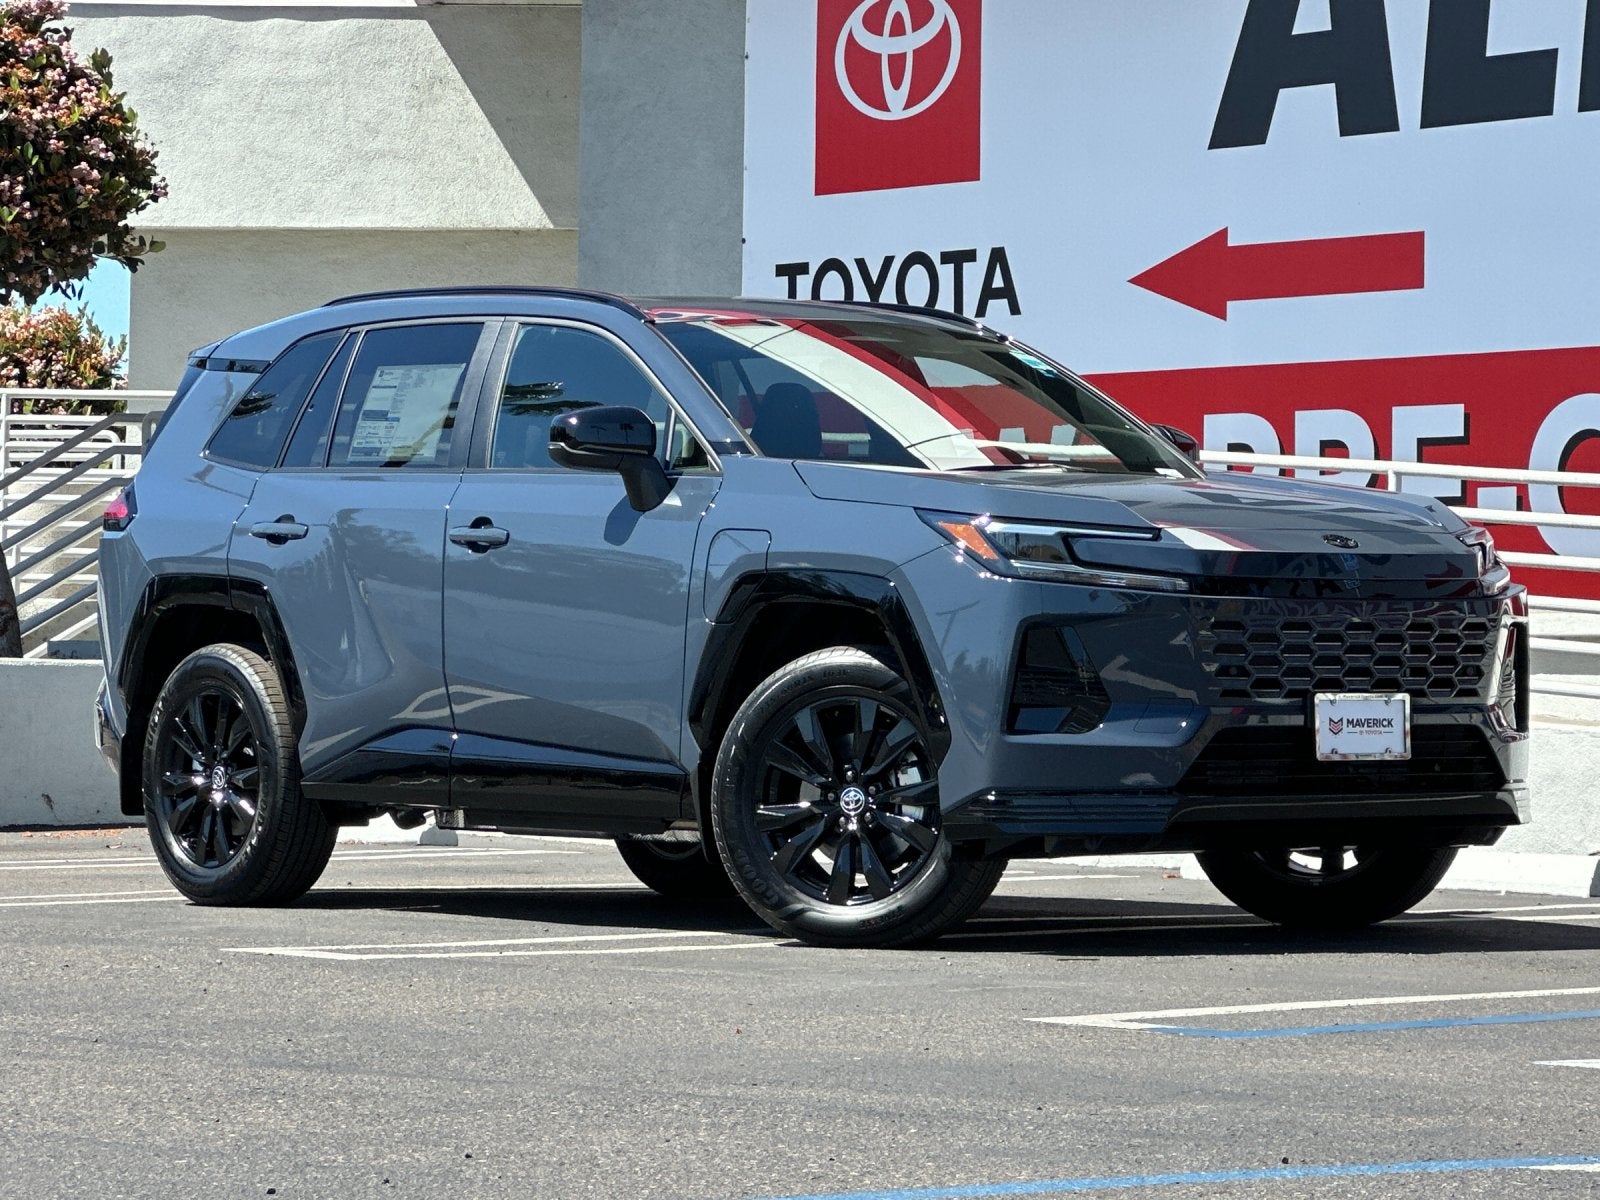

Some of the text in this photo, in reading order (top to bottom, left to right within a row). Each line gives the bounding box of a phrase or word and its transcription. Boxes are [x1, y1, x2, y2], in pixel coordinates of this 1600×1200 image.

[1208, 0, 1600, 150] AL
[775, 246, 1022, 318] TOYOTA
[1346, 718, 1394, 728] MAVERICK
